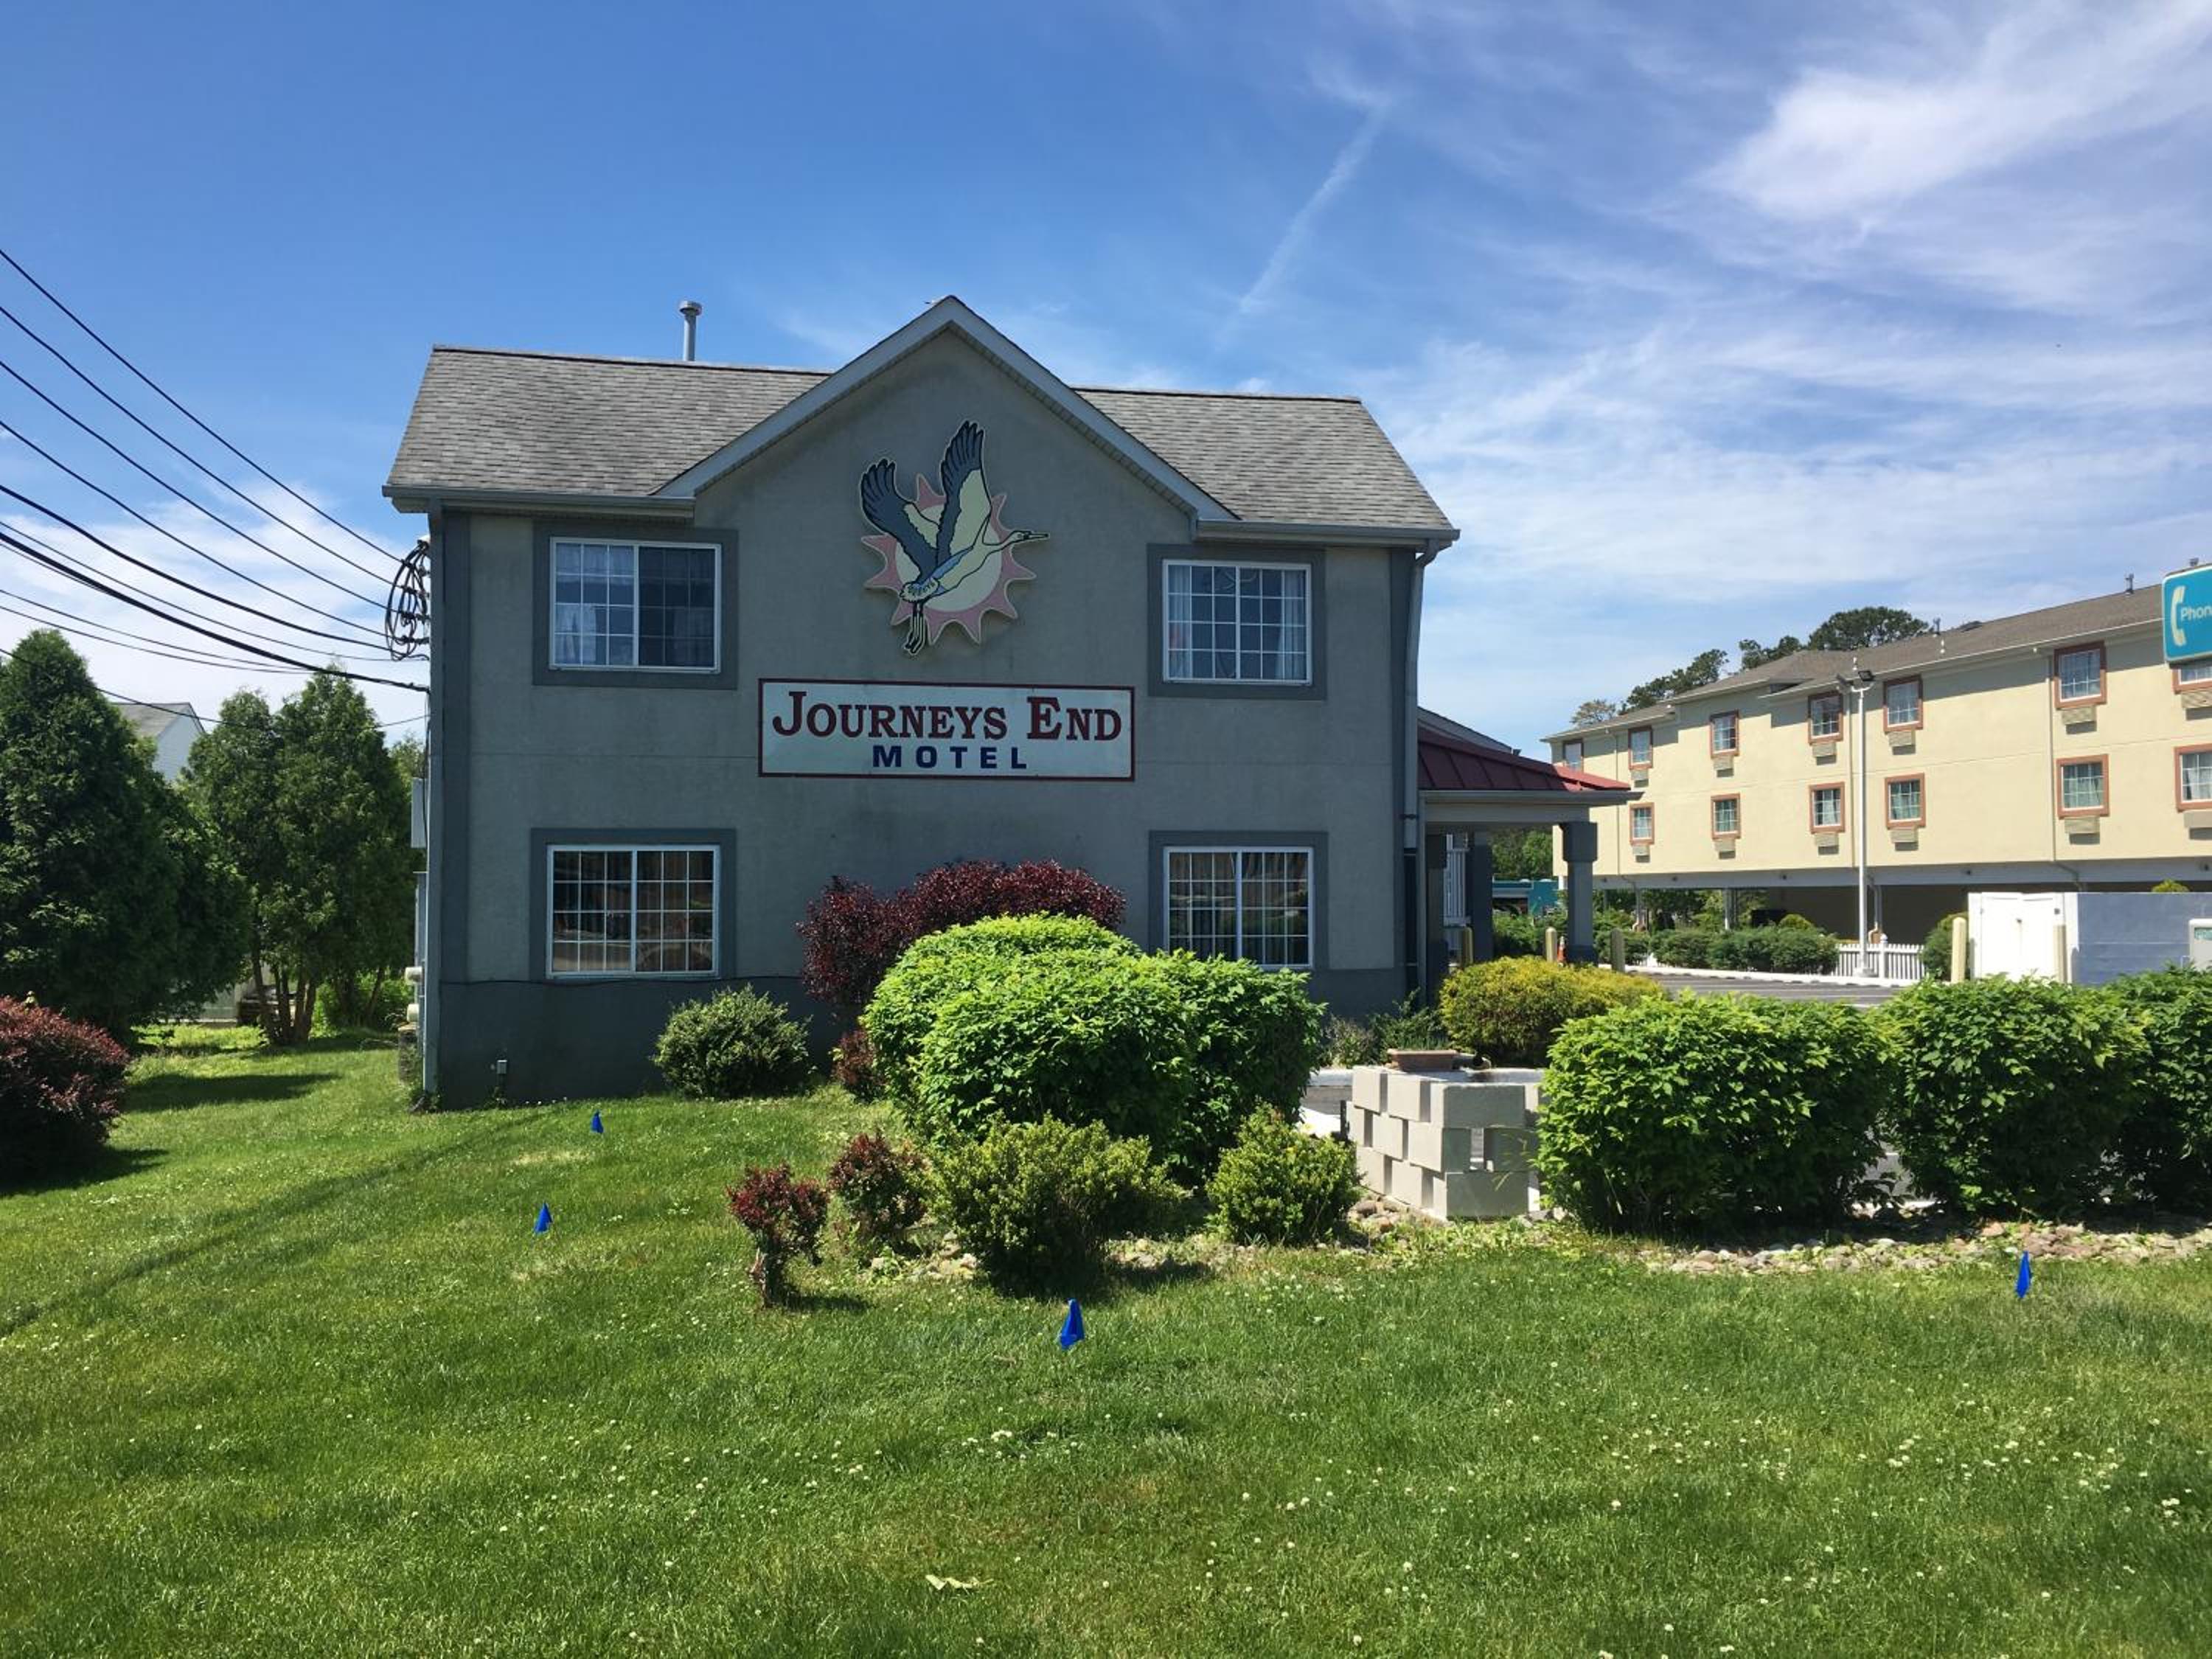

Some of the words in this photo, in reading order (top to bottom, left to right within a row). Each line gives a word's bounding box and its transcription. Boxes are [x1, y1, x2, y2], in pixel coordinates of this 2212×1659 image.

[772, 691, 1008, 740] JOURNEYS
[1026, 696, 1122, 740] END
[872, 745, 1027, 769] MOTEL
